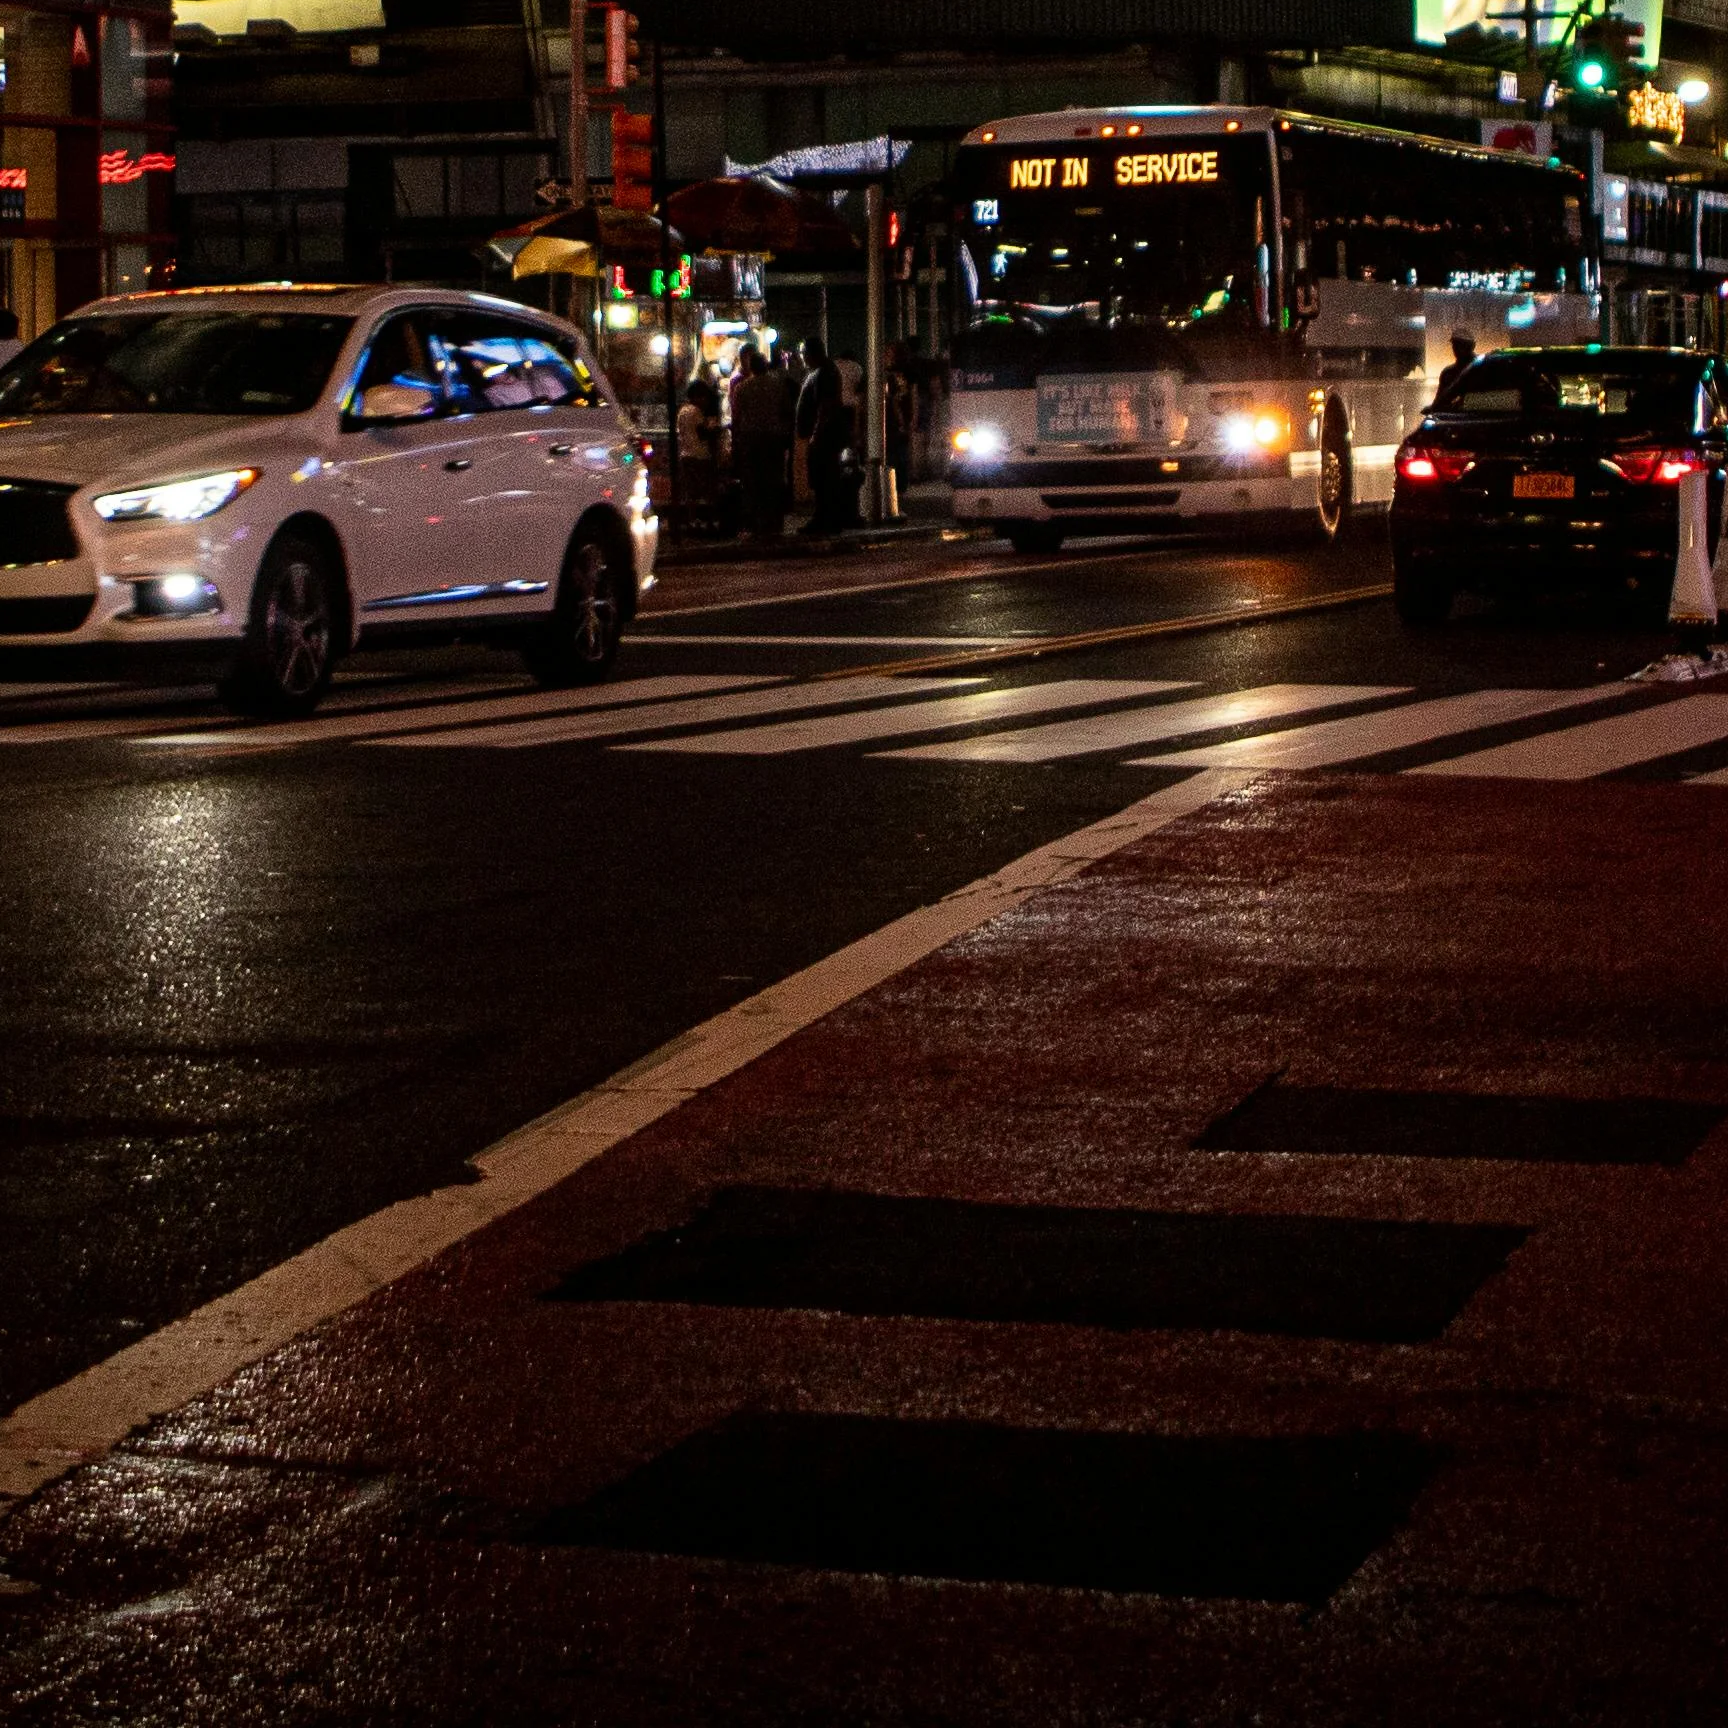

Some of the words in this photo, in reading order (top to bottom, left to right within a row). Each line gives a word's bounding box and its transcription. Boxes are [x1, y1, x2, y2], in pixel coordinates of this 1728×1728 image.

[1010, 159, 1057, 189] NOT
[1061, 158, 1089, 187] IN
[1115, 152, 1219, 184] SERVICE
